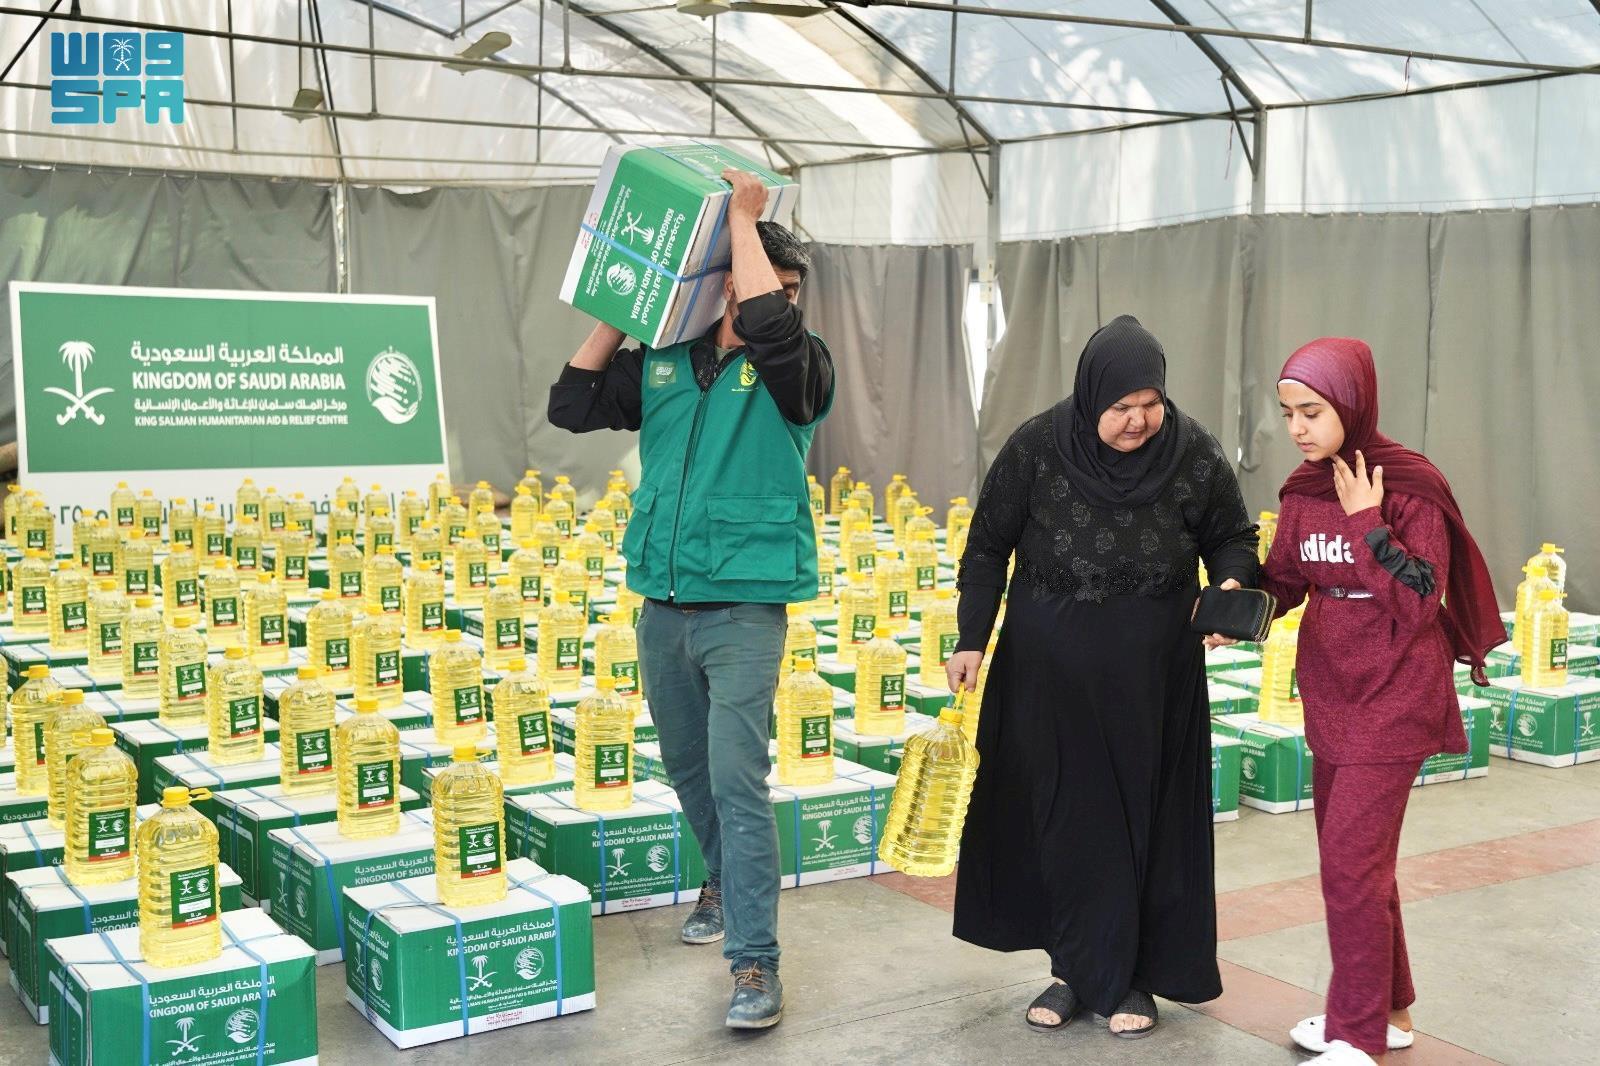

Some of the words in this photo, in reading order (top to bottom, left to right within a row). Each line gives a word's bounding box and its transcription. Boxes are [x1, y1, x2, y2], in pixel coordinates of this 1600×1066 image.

[654, 208, 674, 250] KINGDOM
[631, 288, 645, 319] ARABIA
[131, 341, 215, 366] السعودية
[218, 342, 276, 367] العربية
[279, 344, 344, 366] المملكة
[132, 371, 212, 390] KINGDOM
[214, 372, 236, 390] OF
[239, 372, 287, 390] SAUDI
[289, 373, 346, 390] ARABIA
[134, 397, 181, 412] الإنسانية
[181, 397, 223, 412] والأعمال
[224, 397, 257, 412] للإغاثة
[258, 398, 295, 410] سلمان
[294, 399, 323, 410] الملك
[323, 399, 347, 411] مركز
[135, 415, 157, 427] KING
[158, 415, 197, 426] SALMAN
[198, 415, 265, 426] HUMANITARIAN
[266, 415, 281, 425] AID
[281, 415, 288, 425] &
[289, 415, 316, 425] RELIEF
[316, 414, 348, 425] CENTRE
[3, 810, 42, 822] السعودية
[803, 811, 833, 820] KINGDOM
[843, 806, 861, 814] SAUDI
[627, 825, 652, 835] العربية
[355, 862, 397, 876] السعودية
[398, 856, 428, 868] العربية
[355, 872, 395, 885] KINGDOM
[396, 868, 408, 878] OF
[408, 866, 433, 877] SAUDI
[90, 911, 132, 926] السعودي
[522, 918, 555, 931] لمملكة
[446, 930, 490, 946] السعوية
[491, 925, 521, 938] العربية
[489, 940, 500, 949] OF
[502, 936, 527, 947] SAUDI
[528, 930, 556, 942] ARABIA
[234, 976, 275, 989] الملكة
[198, 983, 233, 998] العربية
[196, 1001, 209, 1010] OF
[211, 995, 240, 1008] SAUDI
[242, 989, 276, 1002] ARAIA
